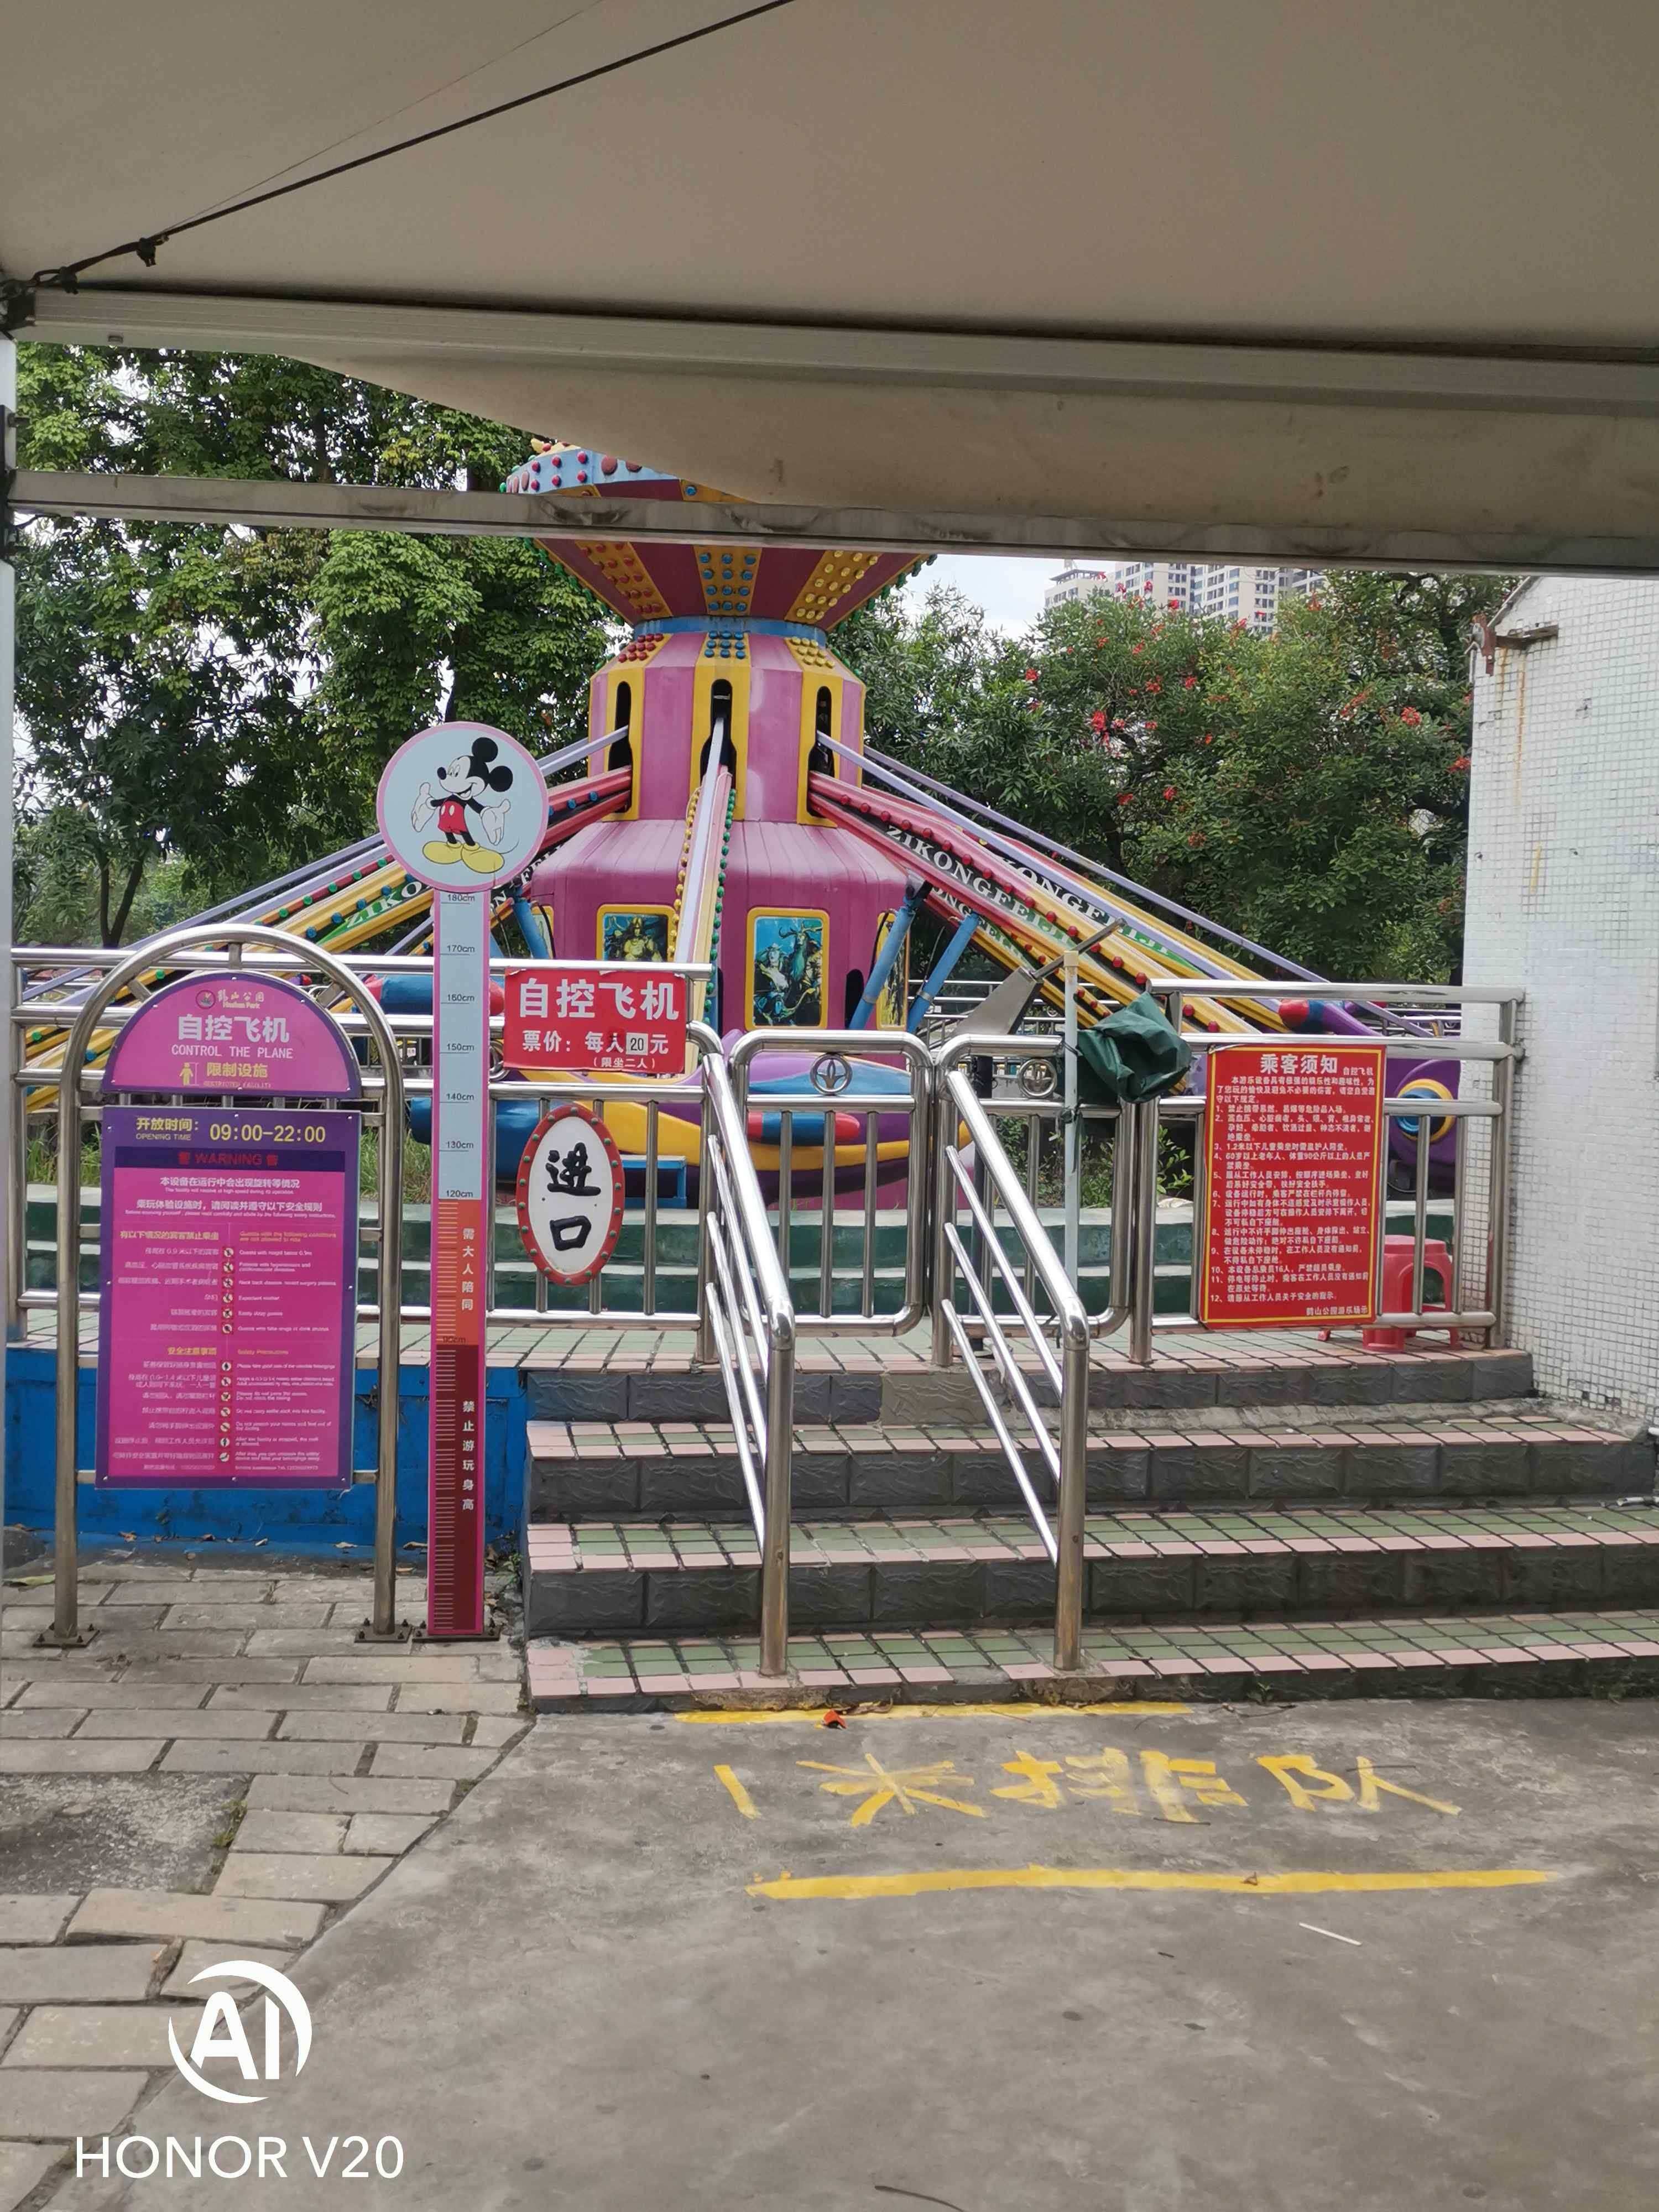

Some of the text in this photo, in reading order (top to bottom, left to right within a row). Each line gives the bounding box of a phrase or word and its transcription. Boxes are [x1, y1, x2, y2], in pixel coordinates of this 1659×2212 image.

[447, 894, 475, 902] 180cm
[447, 945, 475, 953] 170cm
[447, 994, 475, 1003] 160cm
[519, 978, 679, 1021] 自控飞机
[178, 1014, 289, 1044] 自控飞机
[171, 1044, 293, 1058] CONTROL THE PLANE
[447, 1043, 474, 1052] 150cm
[206, 1062, 268, 1078] 限制设施
[1260, 1054, 1374, 1076] 乘客须知 自控飞机
[446, 1093, 474, 1101] 140cm
[210, 1124, 326, 1142] 09:00-22:00
[195, 1153, 262, 1165] WARNING
[462, 1228, 474, 1311] 需大人陪同
[462, 1400, 474, 1511] 禁止游玩身高
